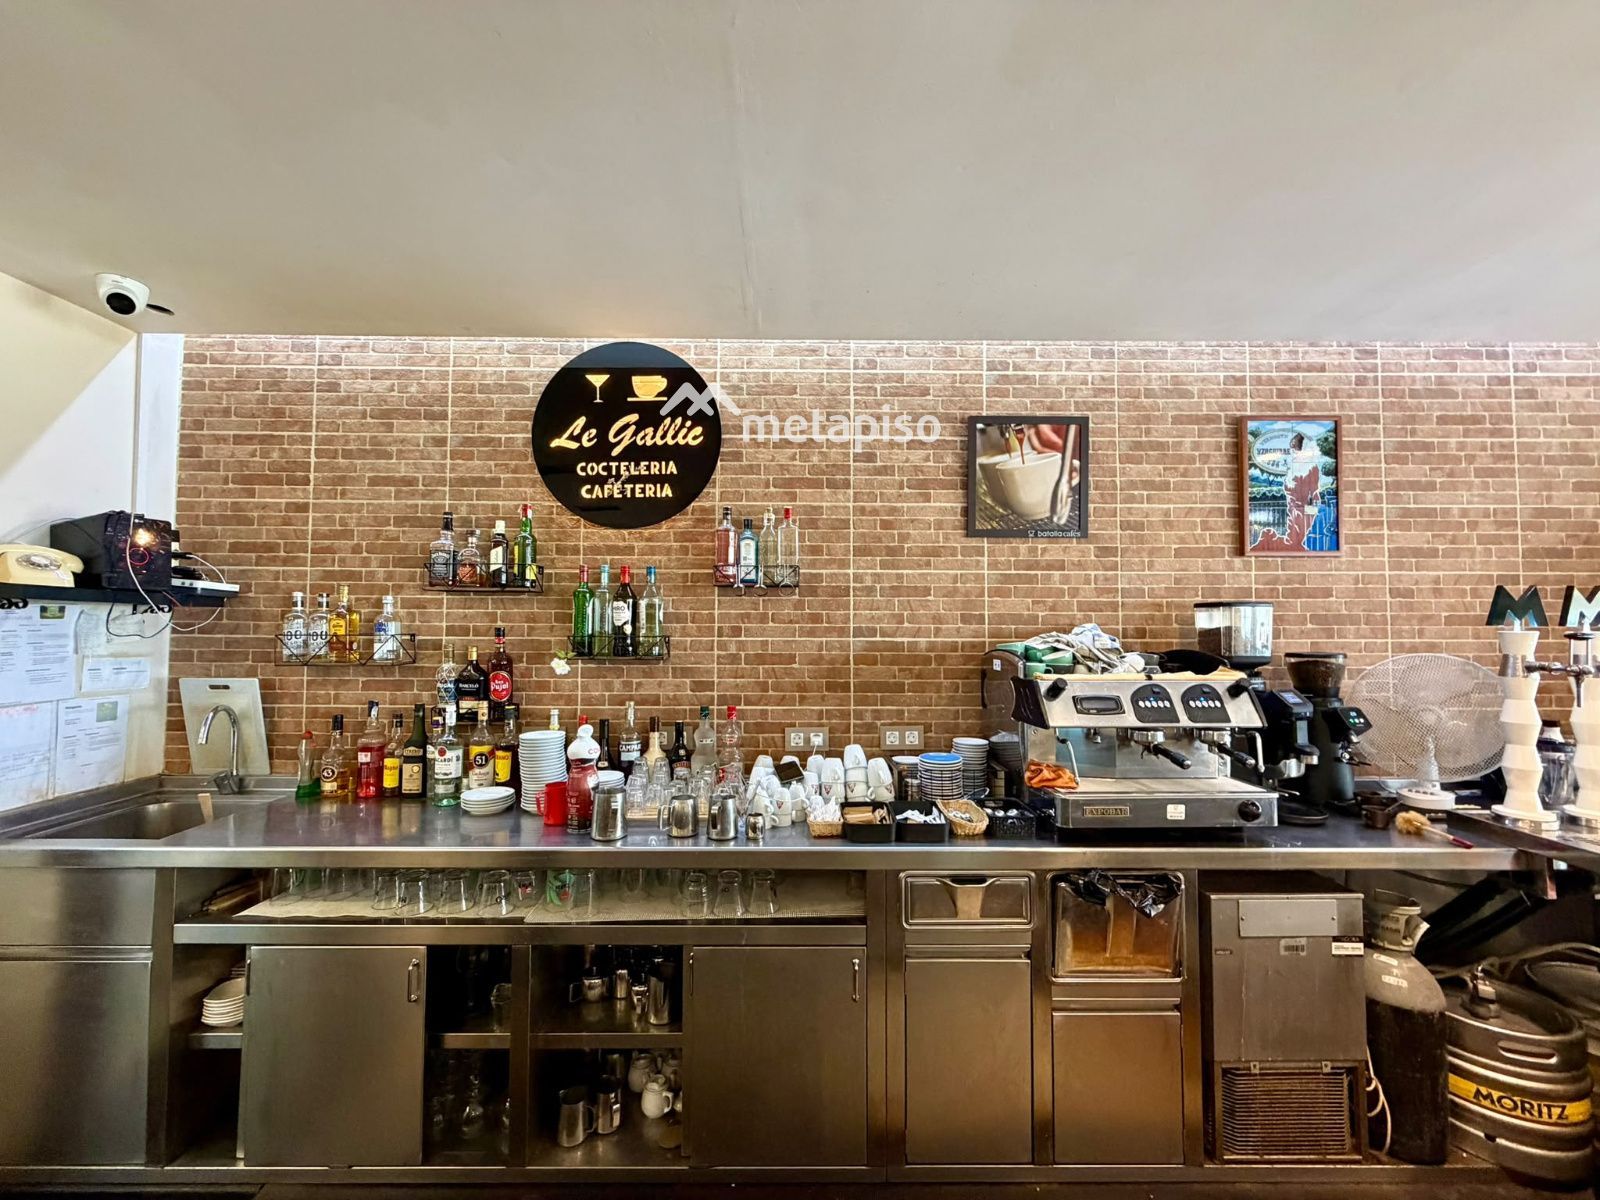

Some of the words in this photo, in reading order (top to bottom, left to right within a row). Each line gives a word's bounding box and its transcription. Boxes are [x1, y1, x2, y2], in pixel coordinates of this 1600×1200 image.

[550, 415, 597, 449] Le
[608, 413, 704, 457] Gallic
[576, 460, 678, 476] COCTELERIA
[580, 483, 673, 499] CAFETERIA
[490, 682, 510, 692] Pujol
[475, 755, 486, 765] 51
[322, 769, 333, 777] 43
[1085, 808, 1128, 816] EXPOBAR
[1473, 1087, 1569, 1120] MORITZ
